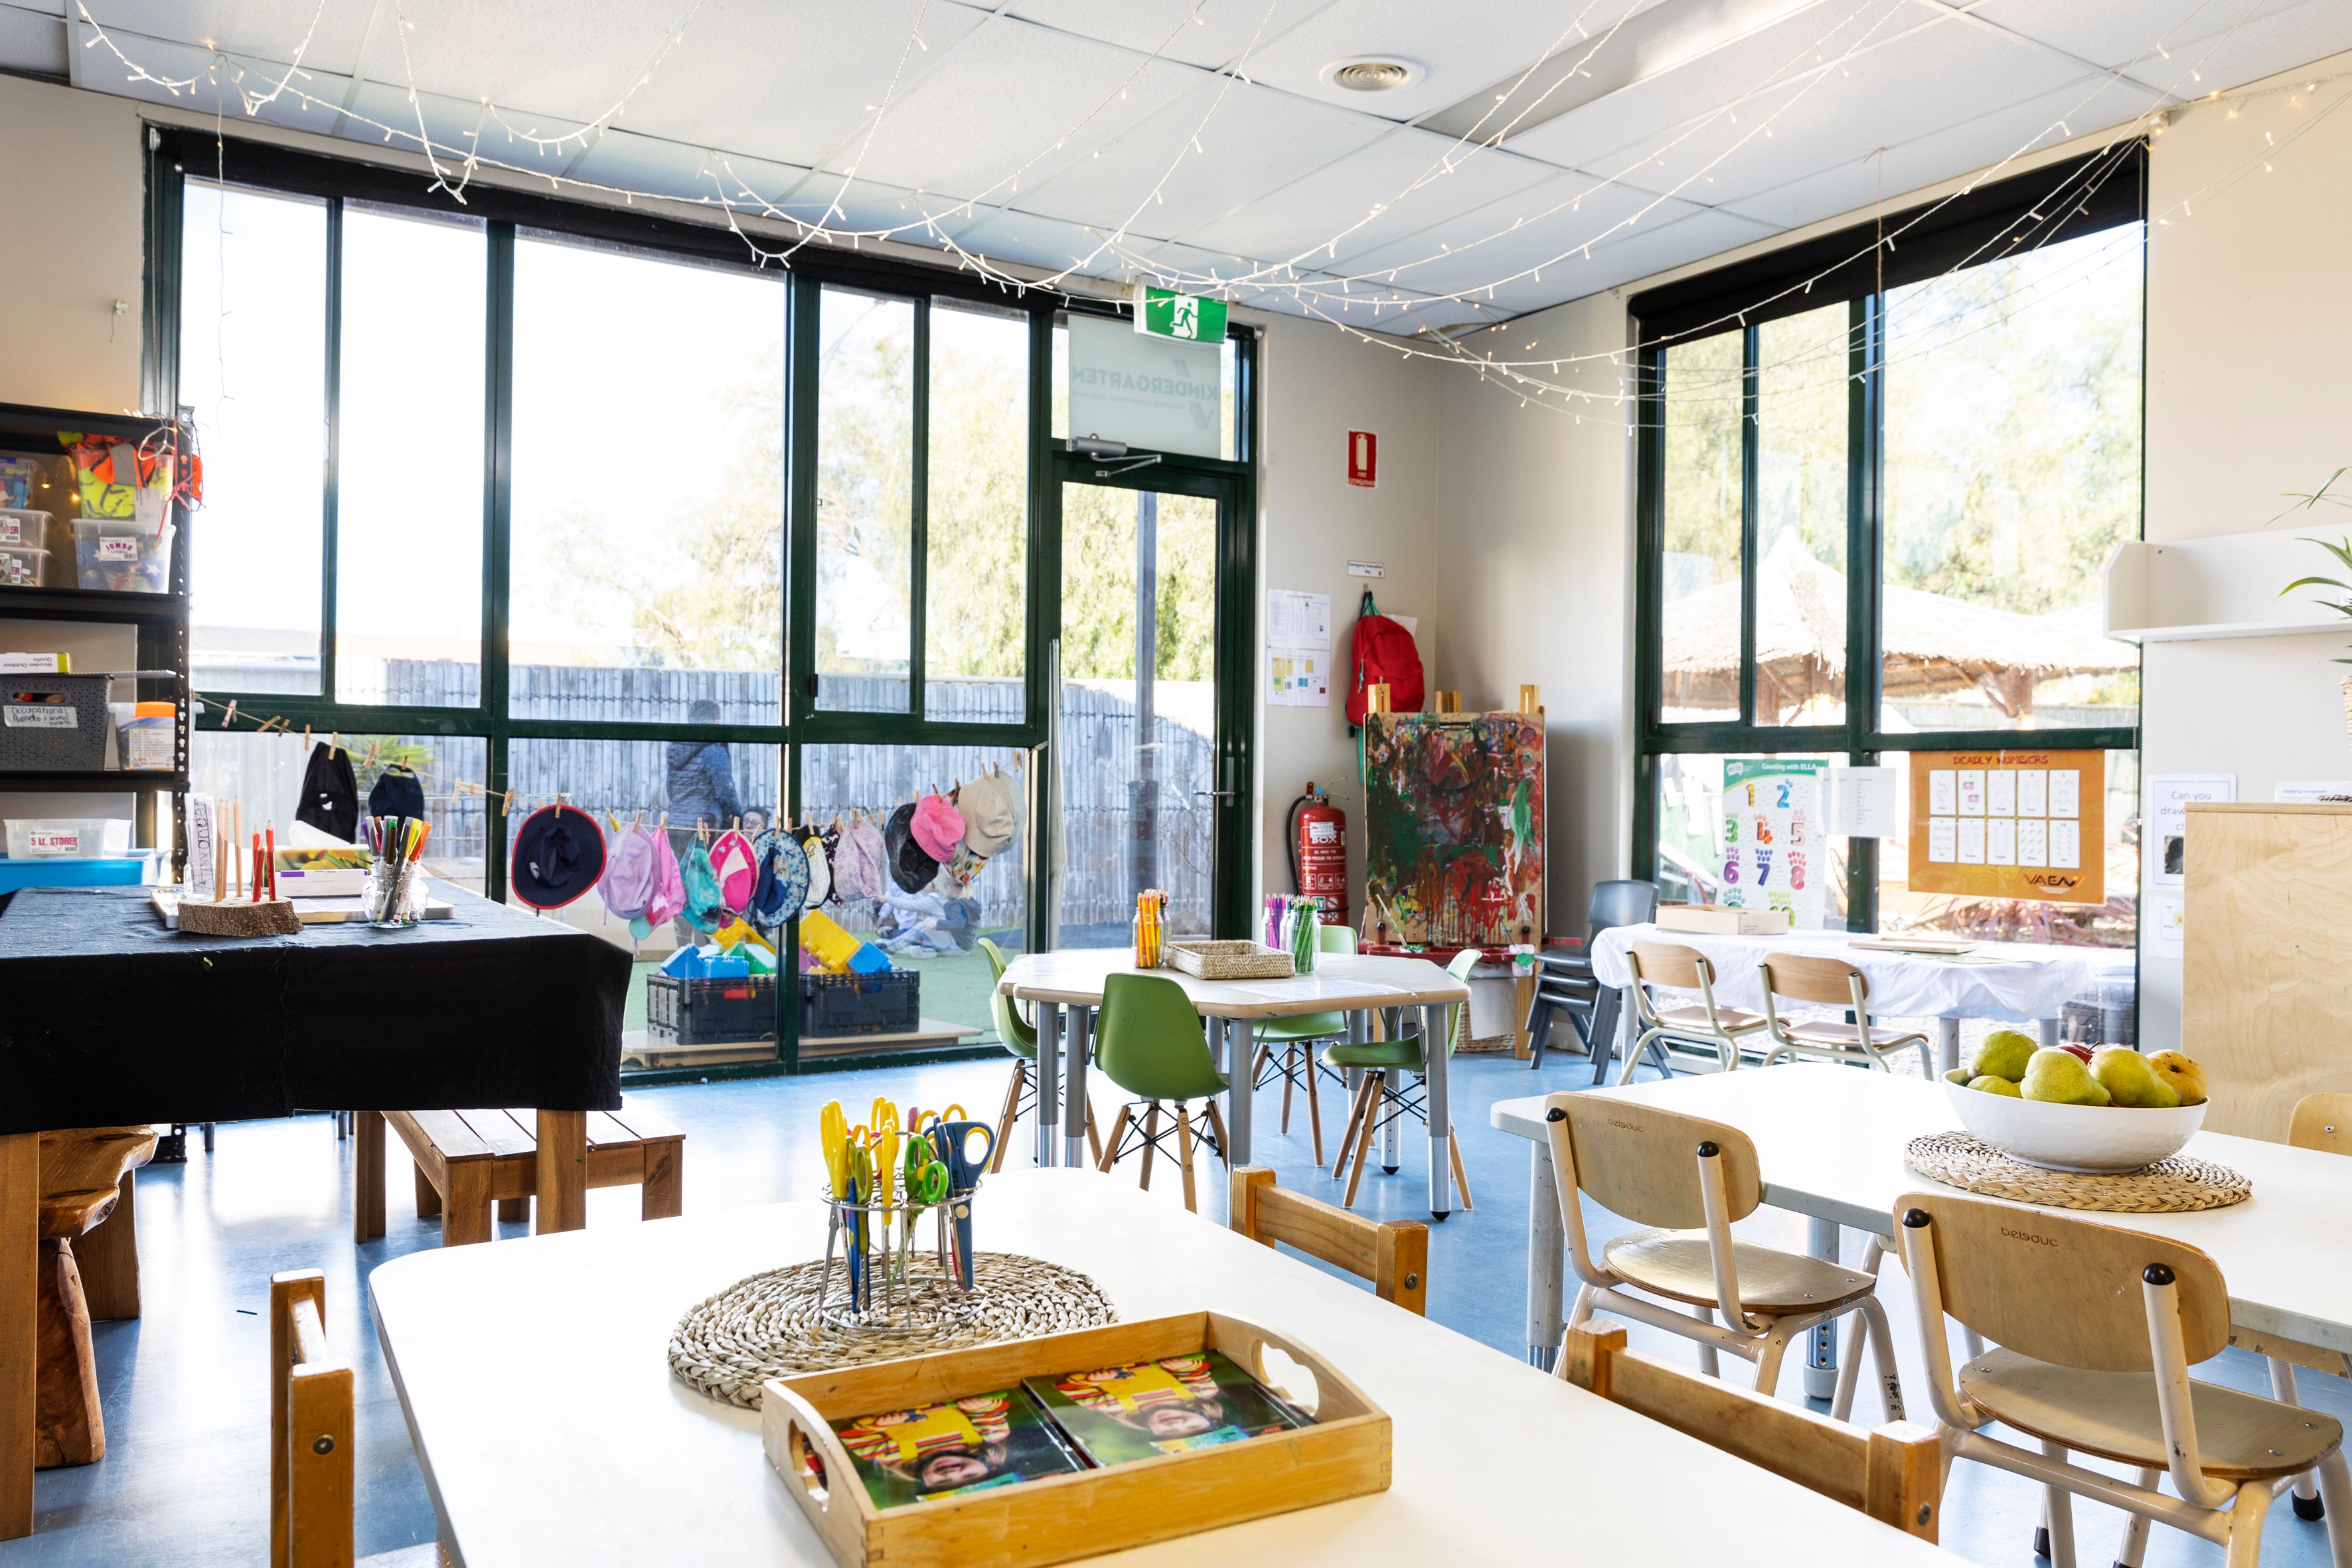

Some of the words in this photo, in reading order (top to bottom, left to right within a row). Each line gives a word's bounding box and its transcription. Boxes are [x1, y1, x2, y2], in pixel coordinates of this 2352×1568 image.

[106, 542, 133, 551] JUMBO
[1953, 756, 1992, 765] DEADLY
[1997, 755, 2049, 765] NUMBERS
[1746, 783, 1755, 808] 1
[1777, 785, 1790, 809] 2
[2171, 791, 2190, 800] Can
[2160, 806, 2185, 815] draw
[31, 837, 36, 846] 5
[50, 836, 78, 846] STORER
[1312, 834, 1337, 844] BOX
[1725, 820, 1739, 842] 3
[1757, 821, 1772, 844] 4
[1791, 822, 1806, 846] 5
[1724, 861, 1739, 884] 6
[1757, 863, 1770, 886] 7
[1790, 866, 1805, 890] 8
